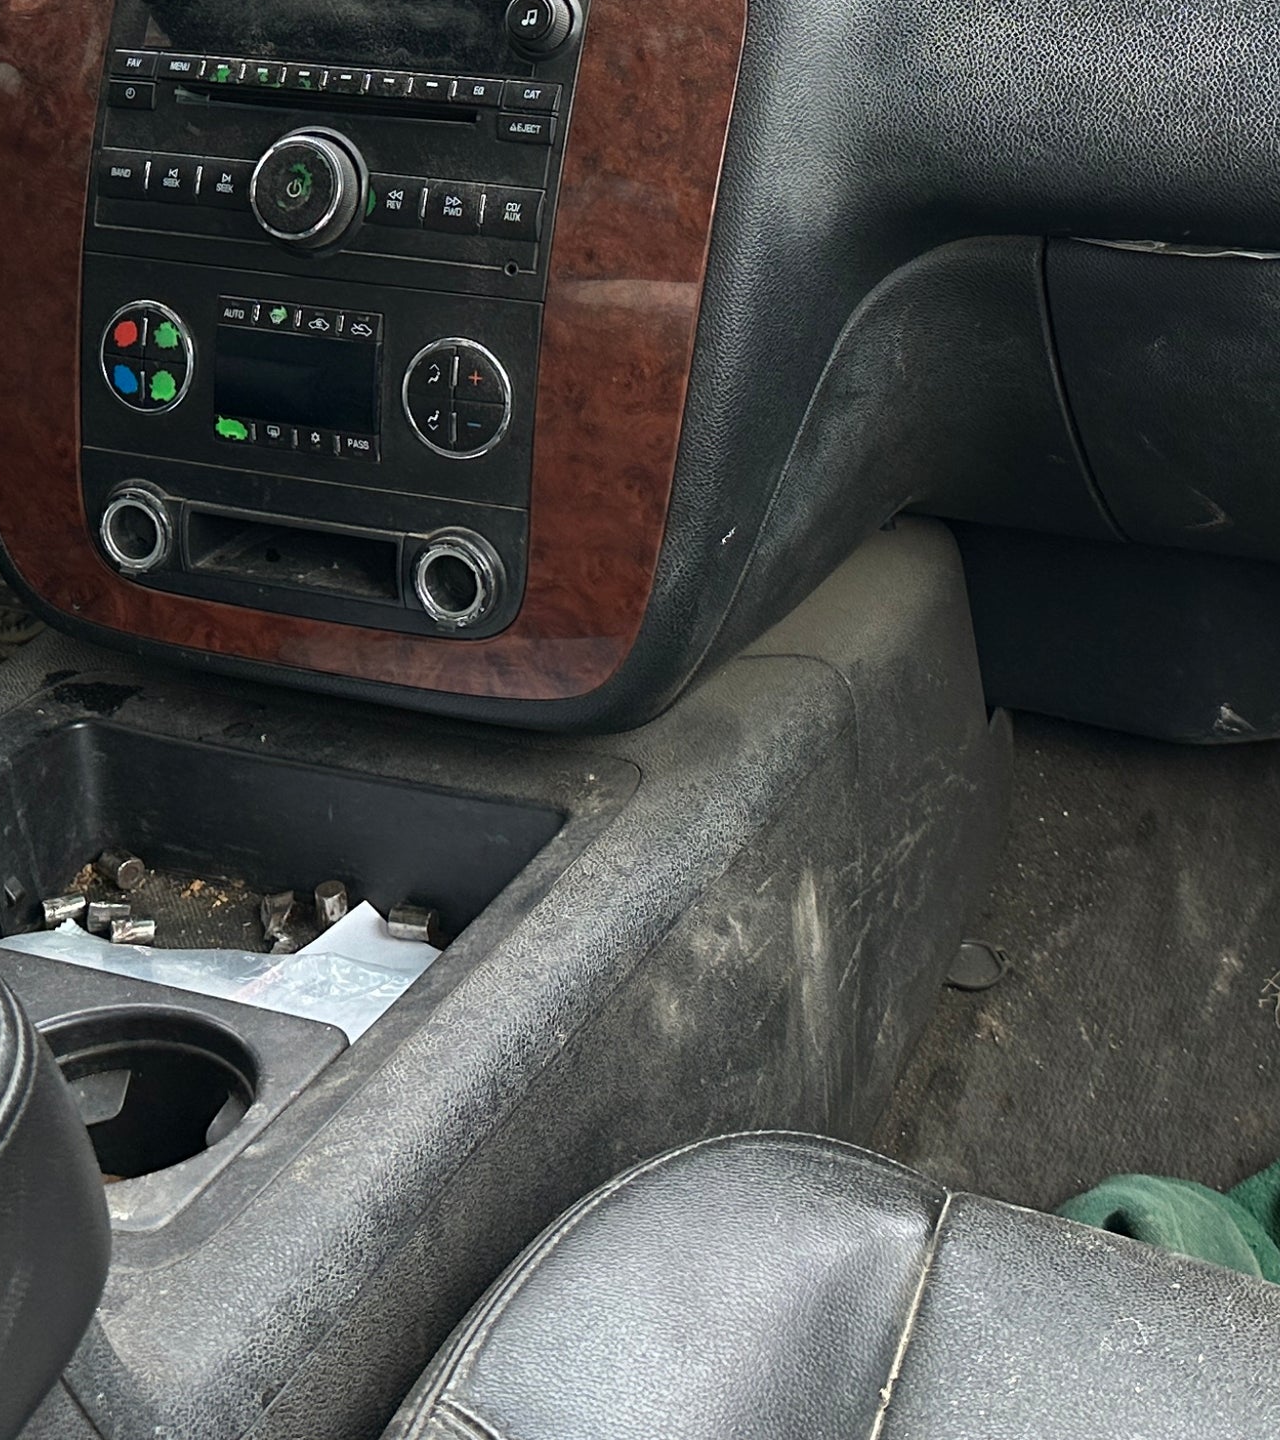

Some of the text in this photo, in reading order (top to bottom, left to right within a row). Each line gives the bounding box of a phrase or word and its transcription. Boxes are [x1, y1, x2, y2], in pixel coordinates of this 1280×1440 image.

[126, 57, 143, 68] FAV
[169, 60, 191, 72] MENU
[473, 85, 485, 96] EQ
[523, 89, 542, 100] CAT
[516, 122, 542, 135] EJECT
[111, 166, 132, 179] BAND
[162, 177, 181, 188] SEEK
[215, 182, 234, 194] SEEK
[386, 200, 402, 211] REV
[443, 206, 463, 217] FWD
[503, 211, 522, 223] AUX
[223, 307, 245, 321] AUTO
[347, 437, 370, 451] PASS
